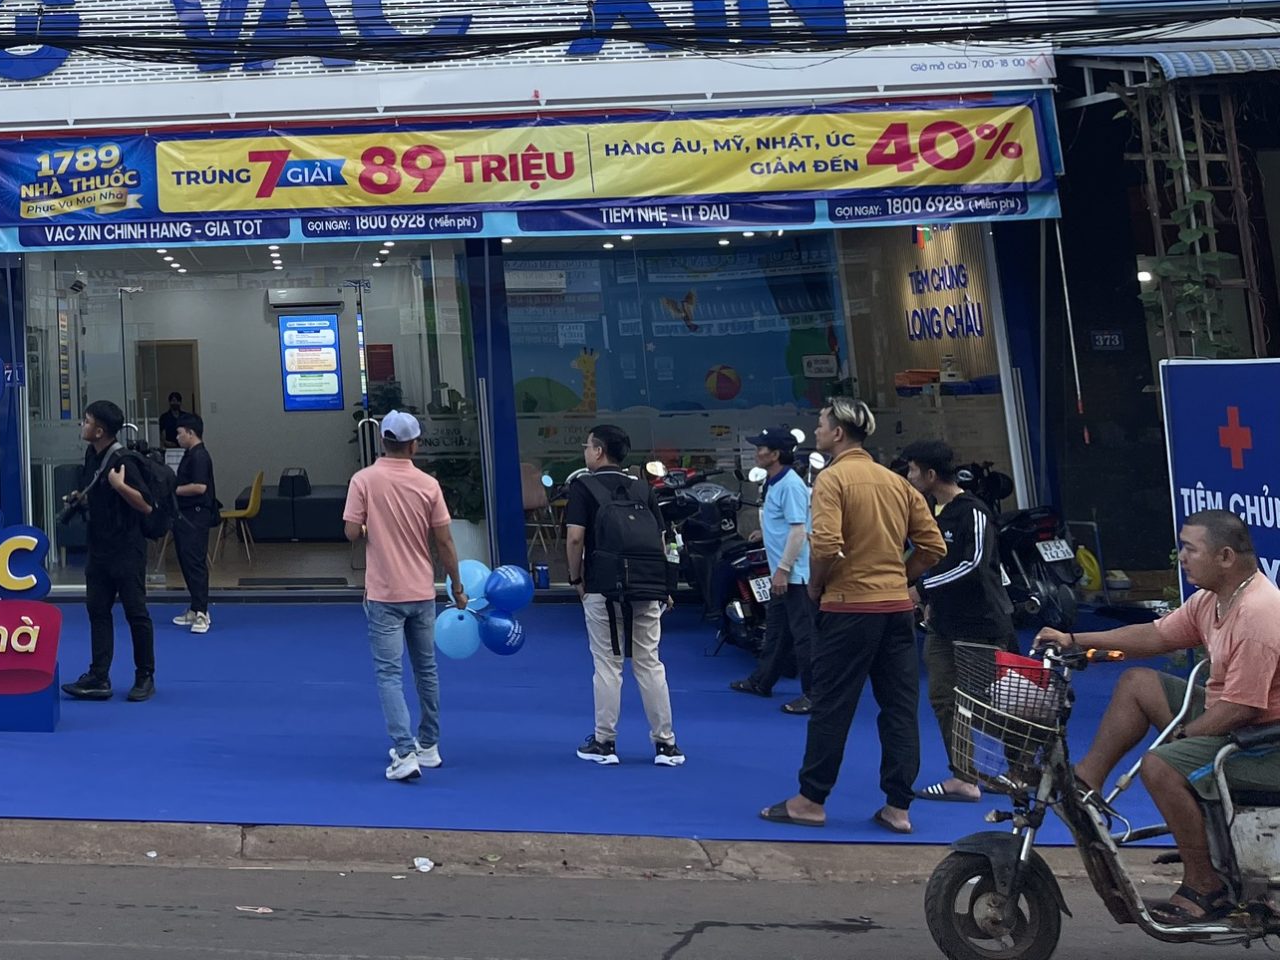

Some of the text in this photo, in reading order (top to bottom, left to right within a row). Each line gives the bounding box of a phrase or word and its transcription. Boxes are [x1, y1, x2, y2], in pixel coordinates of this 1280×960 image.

[604, 128, 856, 157] HÀNG ÂU, MỸ, NHẬT, ÚC
[865, 120, 1024, 174] 40%
[36, 143, 121, 177] 1789
[171, 142, 575, 199] TRÚNG 7 GIẢI 89 TRIỆU
[750, 153, 859, 177] GIẢM ĐẾN
[20, 167, 138, 198] NHÀ THUỐC
[637, 204, 730, 227] NHẸ ĐAU
[835, 196, 964, 219] GỌI NGAY: 1800 6928
[78, 224, 101, 240] XIN
[307, 213, 426, 234] GỌI NGAY: 1800 6928
[930, 258, 968, 292] CHỦNG
[905, 291, 985, 341] LONG CHÂU
[1095, 334, 1120, 346] 373
[1180, 481, 1223, 517] TIÊM
